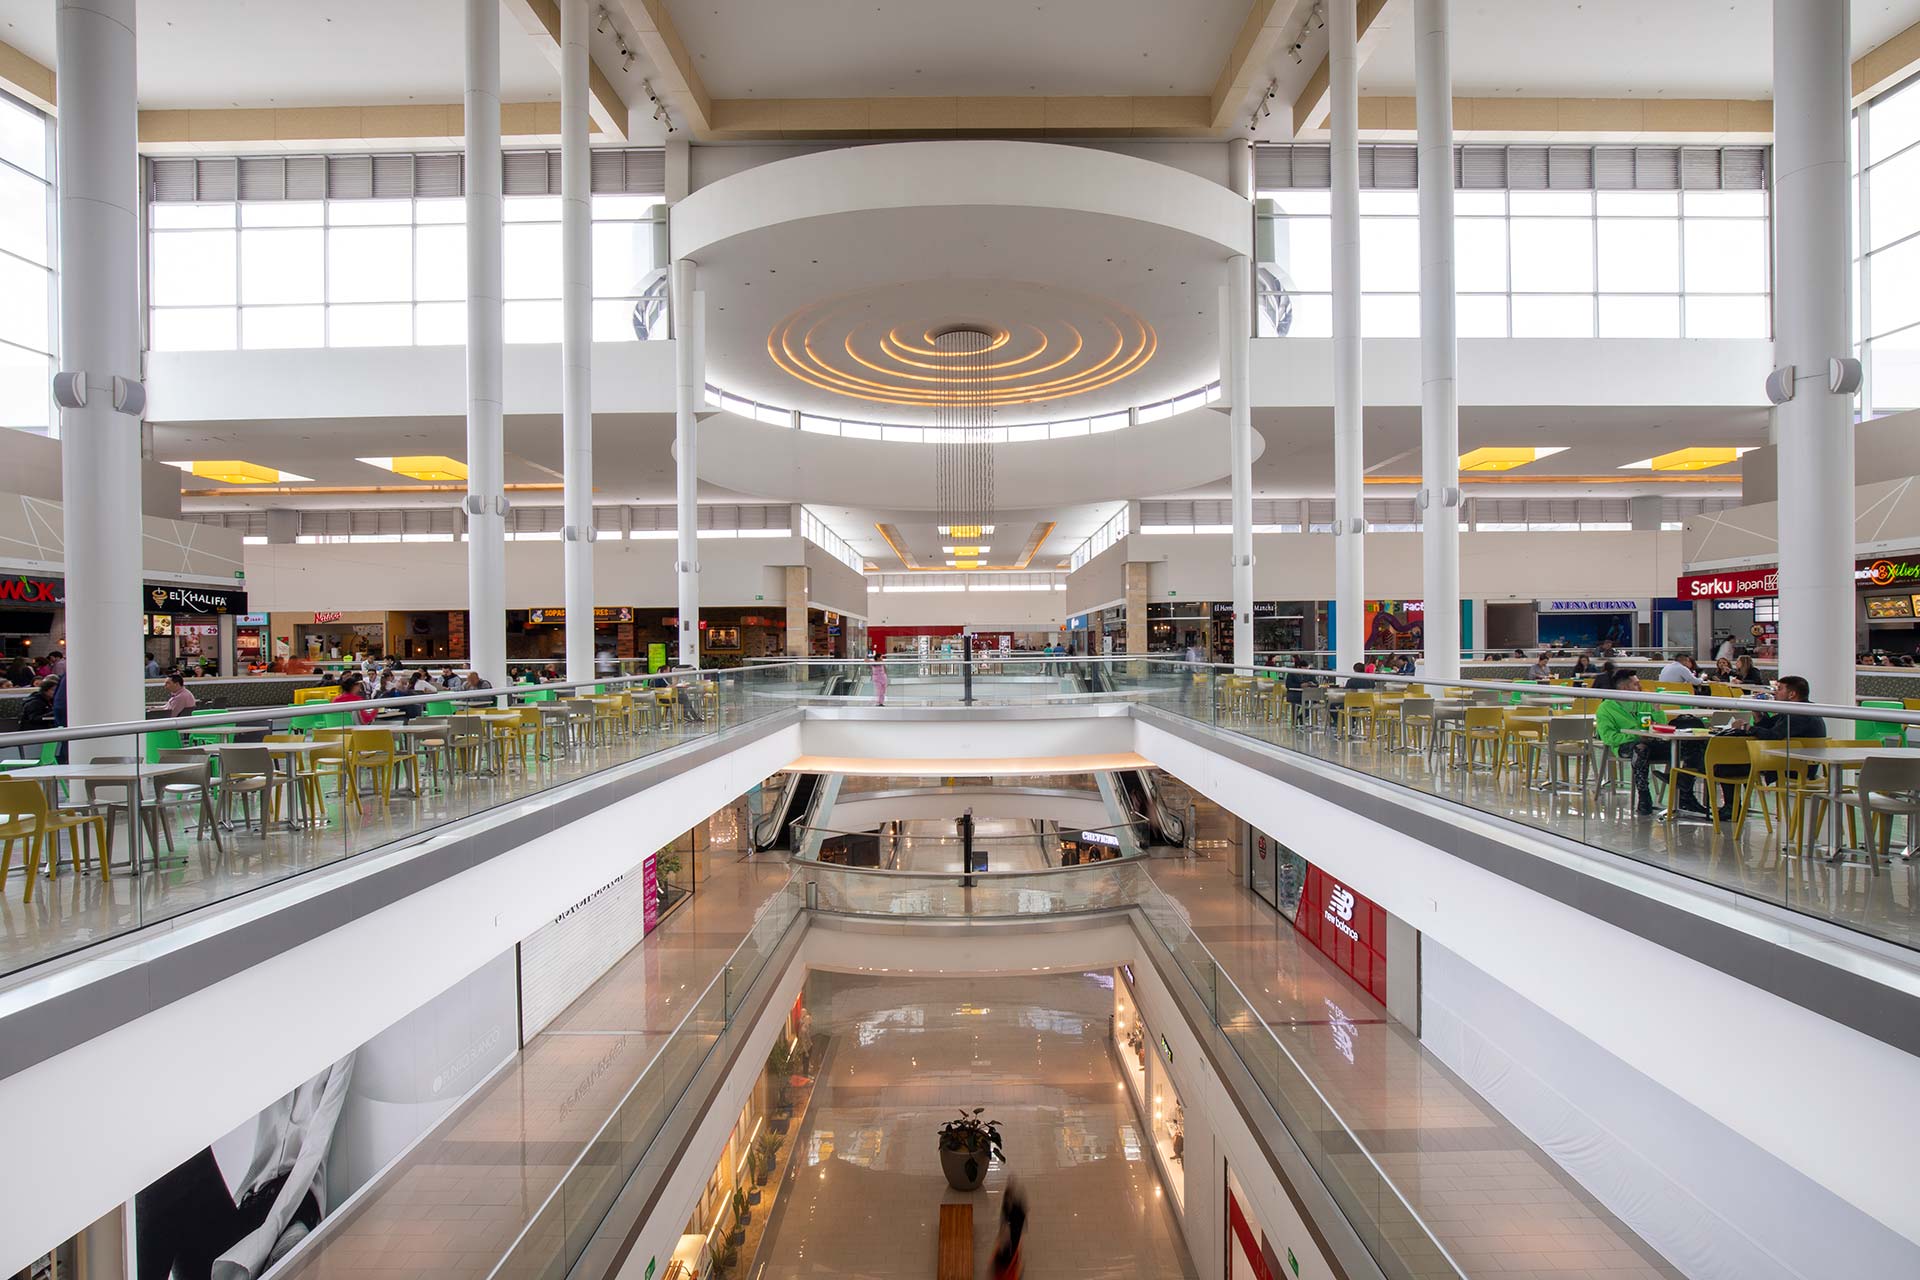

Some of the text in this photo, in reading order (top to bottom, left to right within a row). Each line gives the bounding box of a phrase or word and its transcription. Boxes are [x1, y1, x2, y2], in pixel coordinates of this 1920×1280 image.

[0, 578, 56, 603] WOK
[1691, 578, 1764, 596] Sarku japan
[169, 591, 180, 600] EL
[177, 589, 228, 613] KHALIFA
[1551, 600, 1637, 610] AVENA CUBANA
[1324, 910, 1359, 942] new balance
